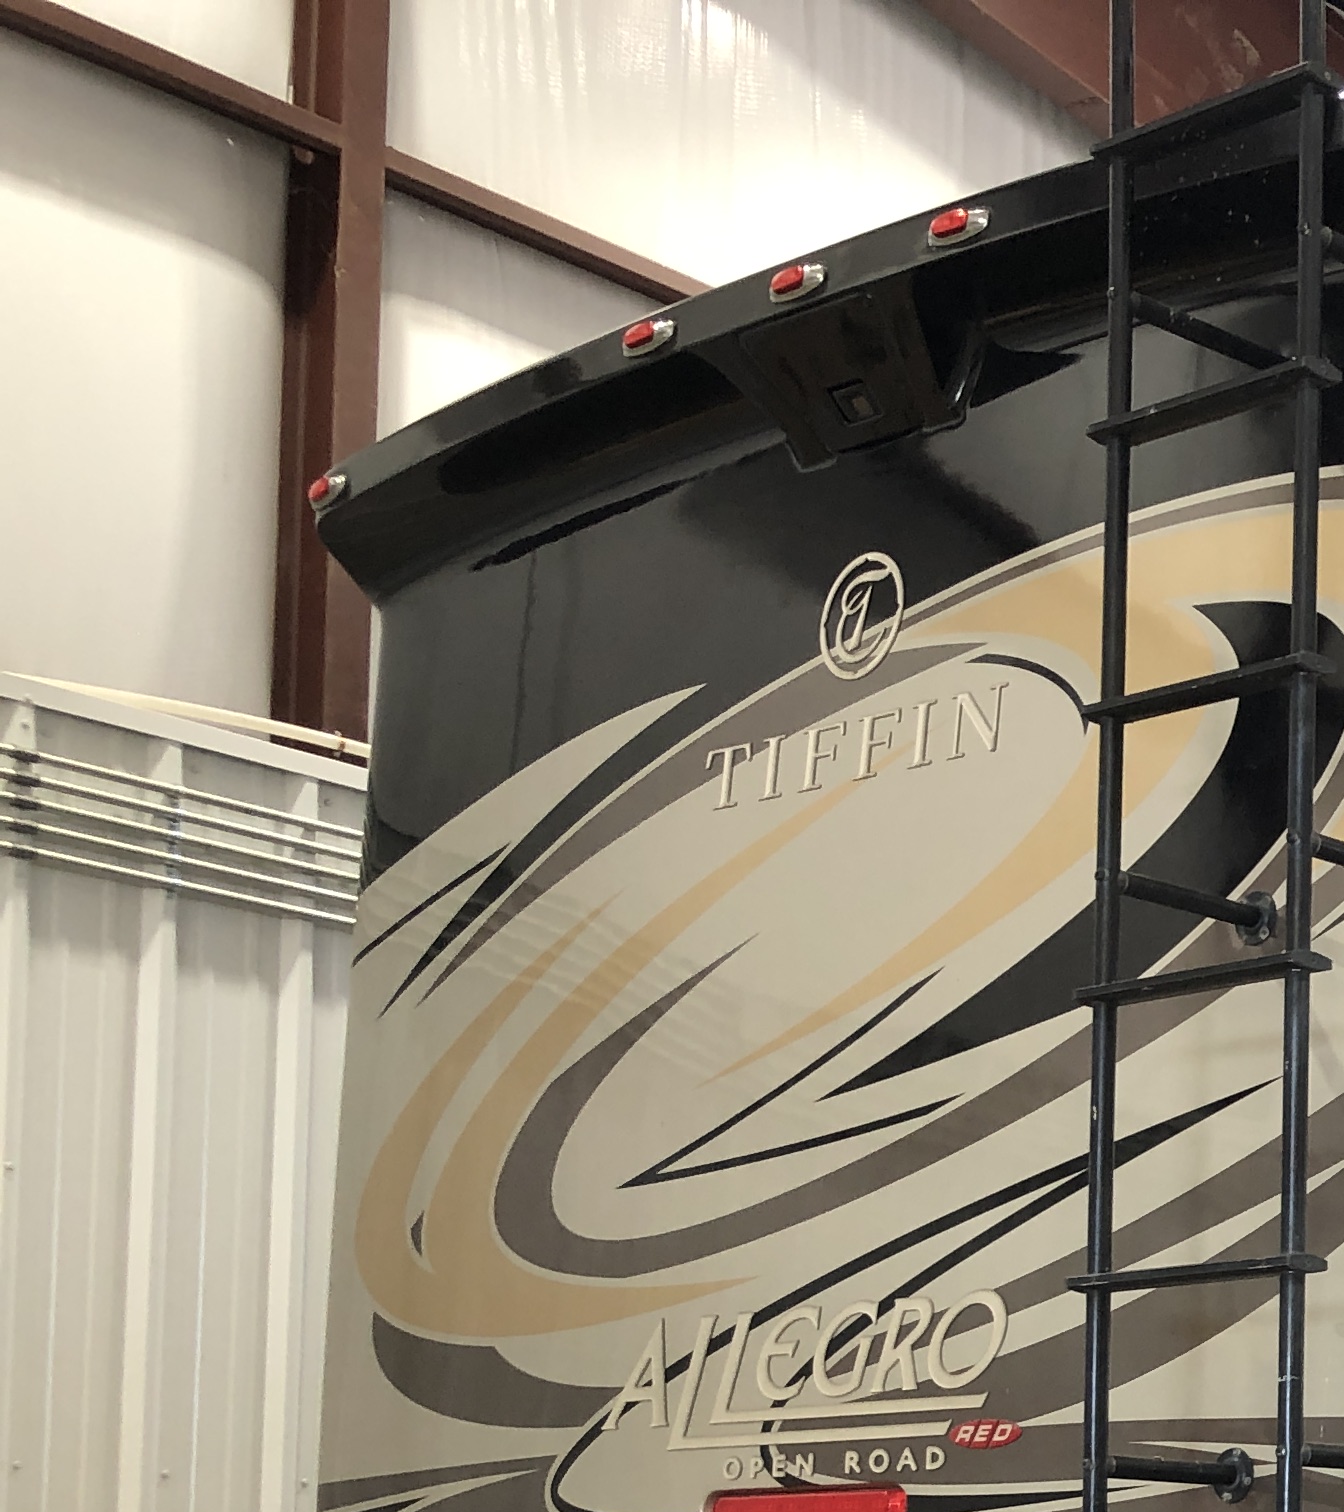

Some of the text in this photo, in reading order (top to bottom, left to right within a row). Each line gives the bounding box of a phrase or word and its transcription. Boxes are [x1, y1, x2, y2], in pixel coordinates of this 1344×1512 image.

[704, 680, 1010, 812] TIFFIN
[601, 1288, 1009, 1451] ALLEGRO
[722, 1444, 947, 1481] OPEN ROAD
[953, 1421, 1014, 1445] RED
